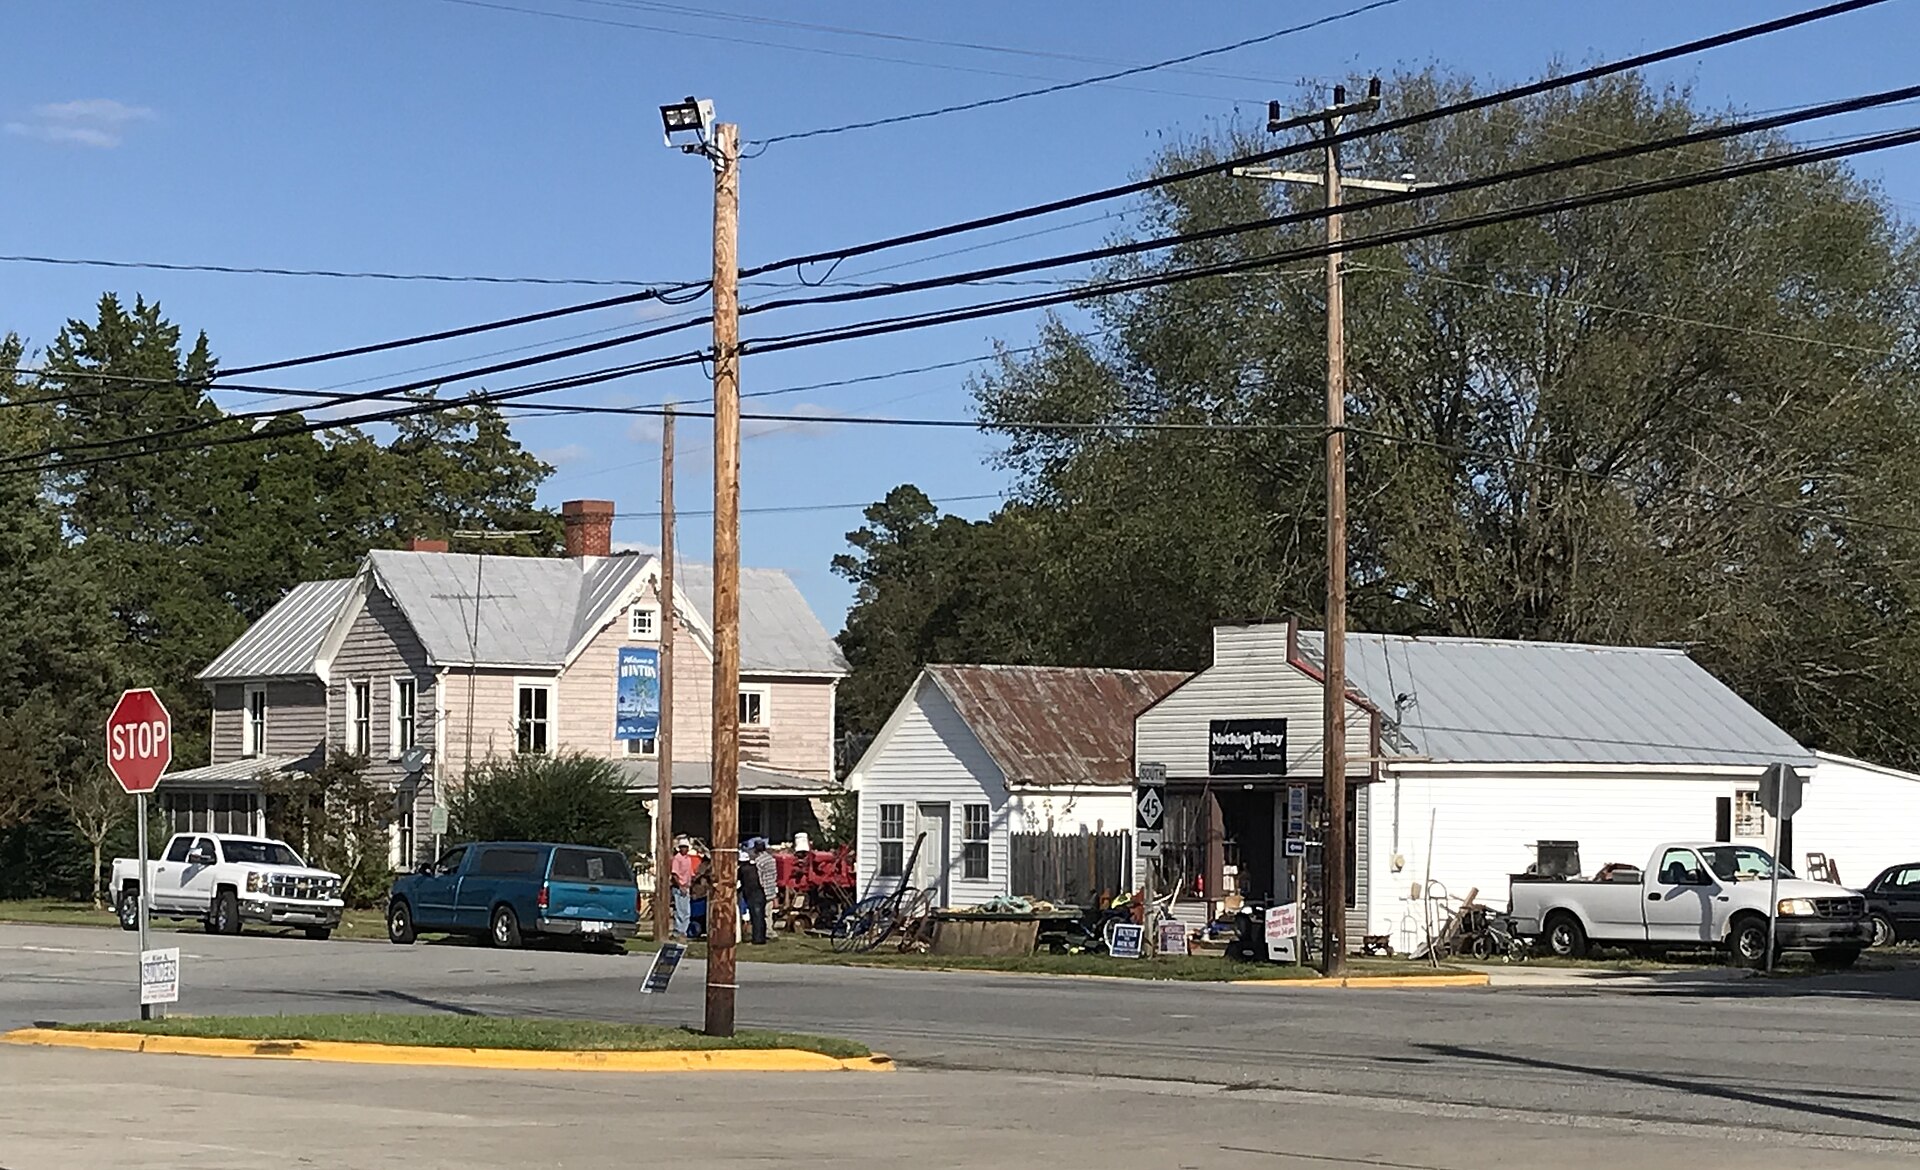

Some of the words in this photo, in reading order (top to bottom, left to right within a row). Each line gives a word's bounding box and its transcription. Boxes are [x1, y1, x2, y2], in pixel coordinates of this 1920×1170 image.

[112, 721, 166, 761] STOP
[1212, 731, 1252, 750] Nothing
[1253, 731, 1284, 747] Fancy
[1141, 768, 1165, 780] SOUTH
[1143, 798, 1158, 818] 45
